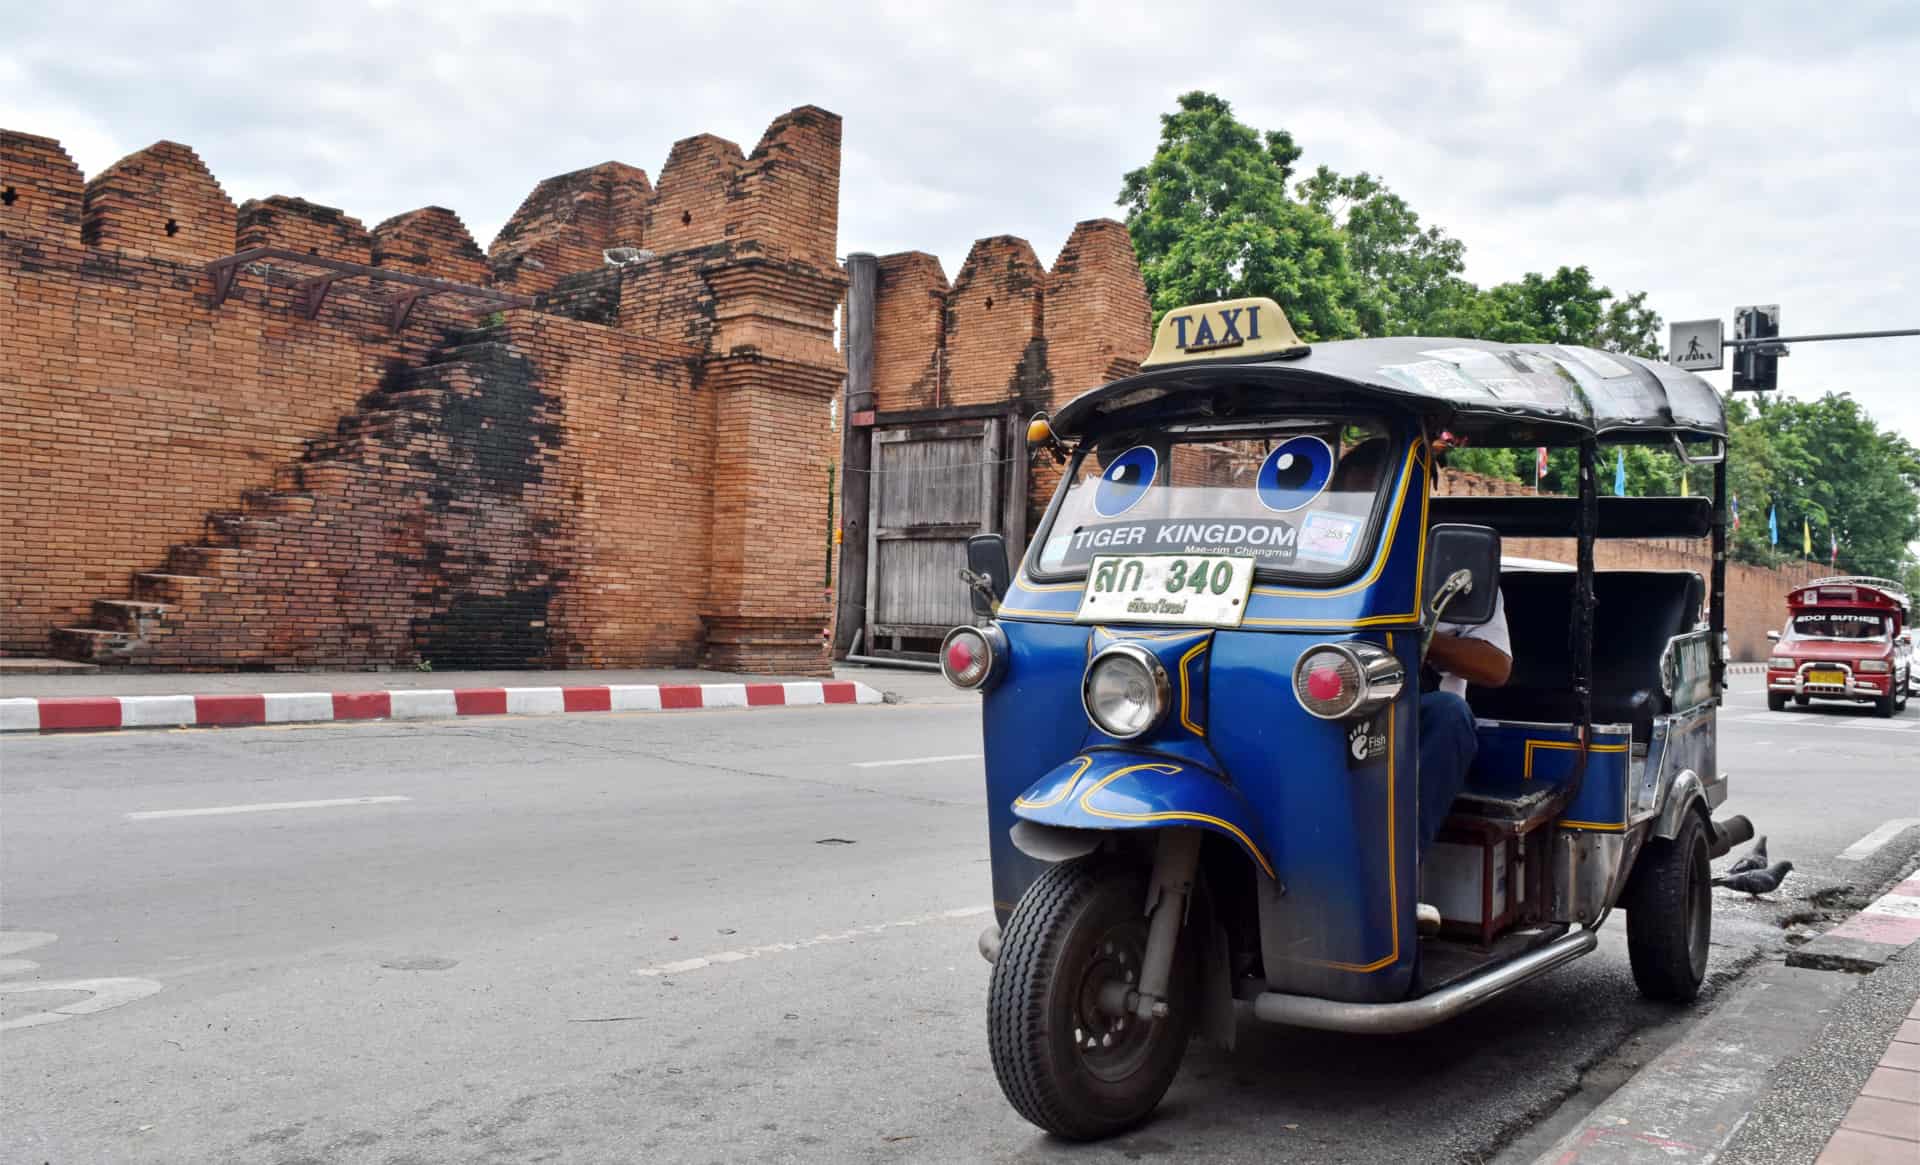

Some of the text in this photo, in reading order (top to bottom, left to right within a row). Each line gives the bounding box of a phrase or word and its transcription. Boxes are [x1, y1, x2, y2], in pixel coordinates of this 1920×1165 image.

[1170, 306, 1262, 349] TAXI
[1076, 525, 1296, 548] TIGER KINGDOM
[1234, 546, 1293, 558] Chiangmai
[1095, 558, 1233, 595] สก 340
[1369, 734, 1386, 748] Fish
